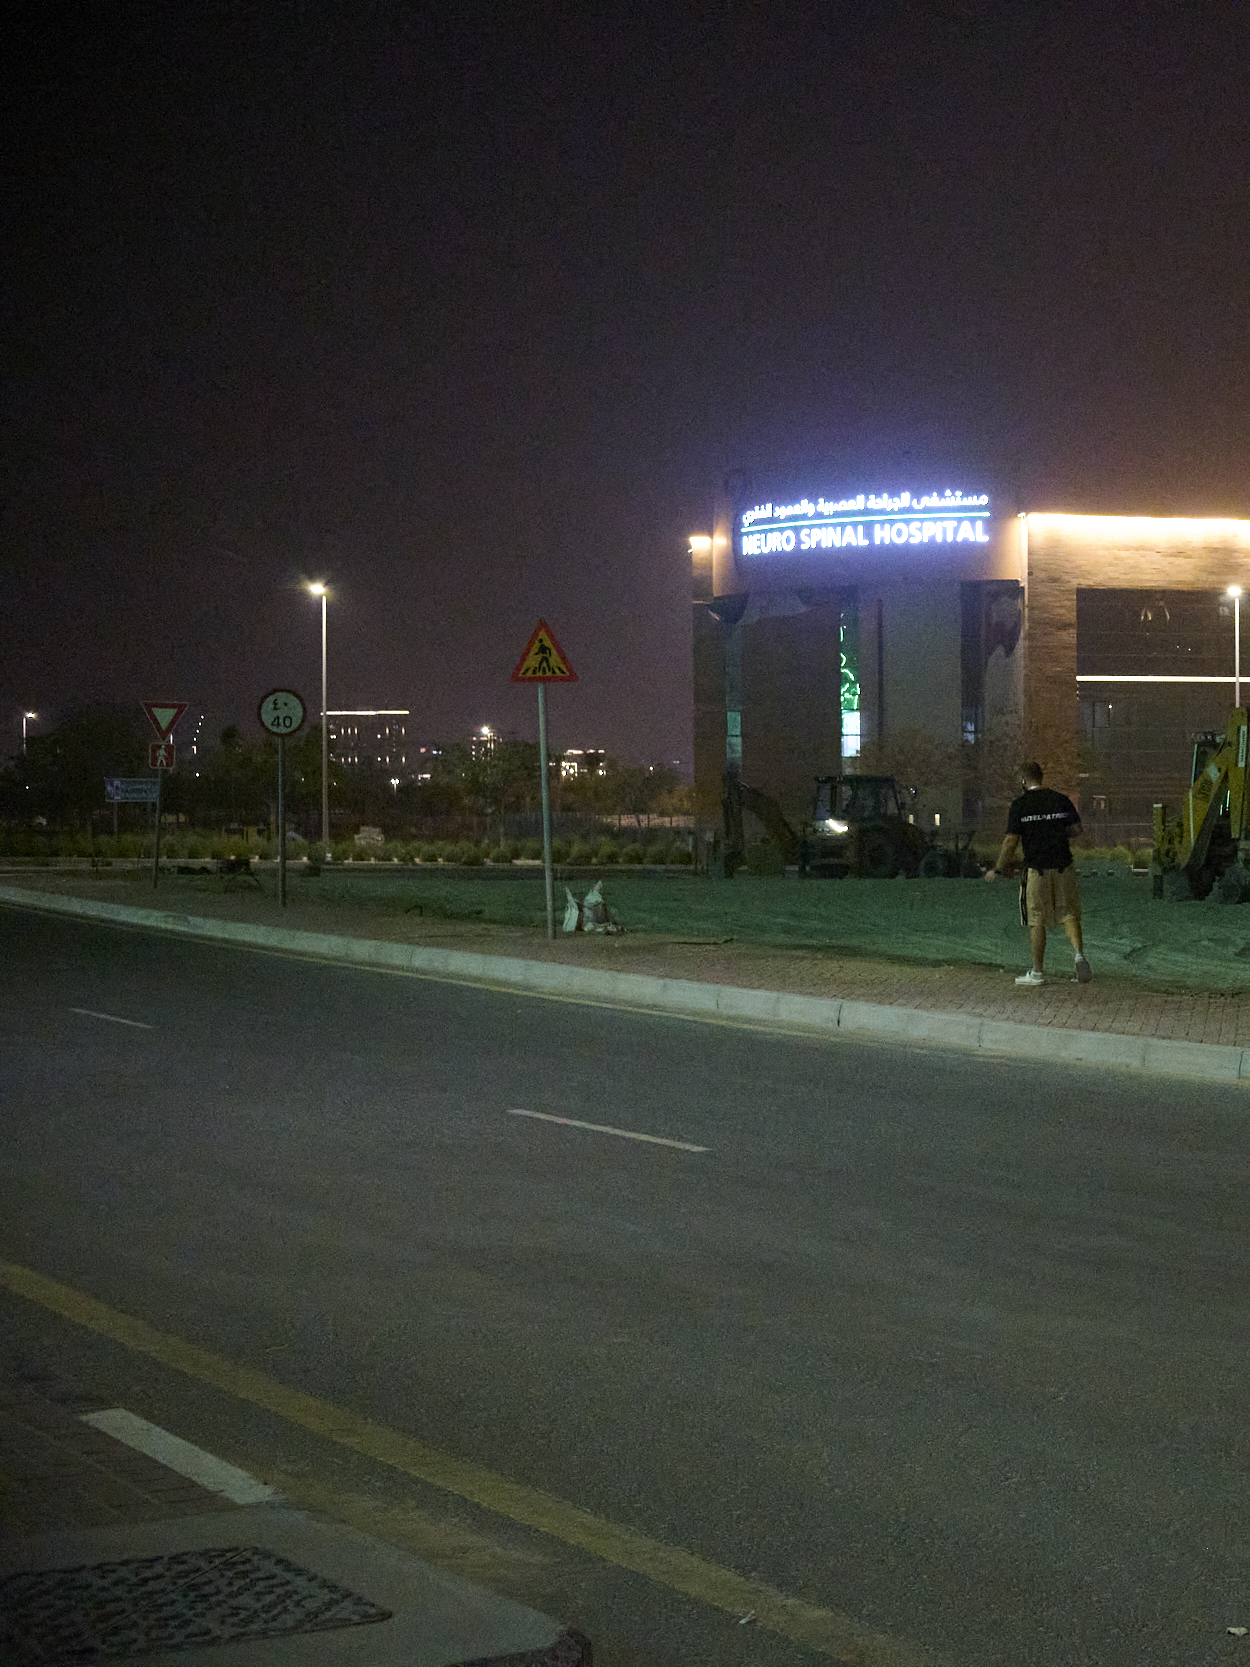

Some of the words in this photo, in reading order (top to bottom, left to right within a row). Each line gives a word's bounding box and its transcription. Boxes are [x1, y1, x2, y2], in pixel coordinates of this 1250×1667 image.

[742, 529, 796, 556] NEURO
[800, 525, 869, 550] SPINAL
[874, 520, 990, 545] HOSPITAL
[270, 715, 293, 728] 40
